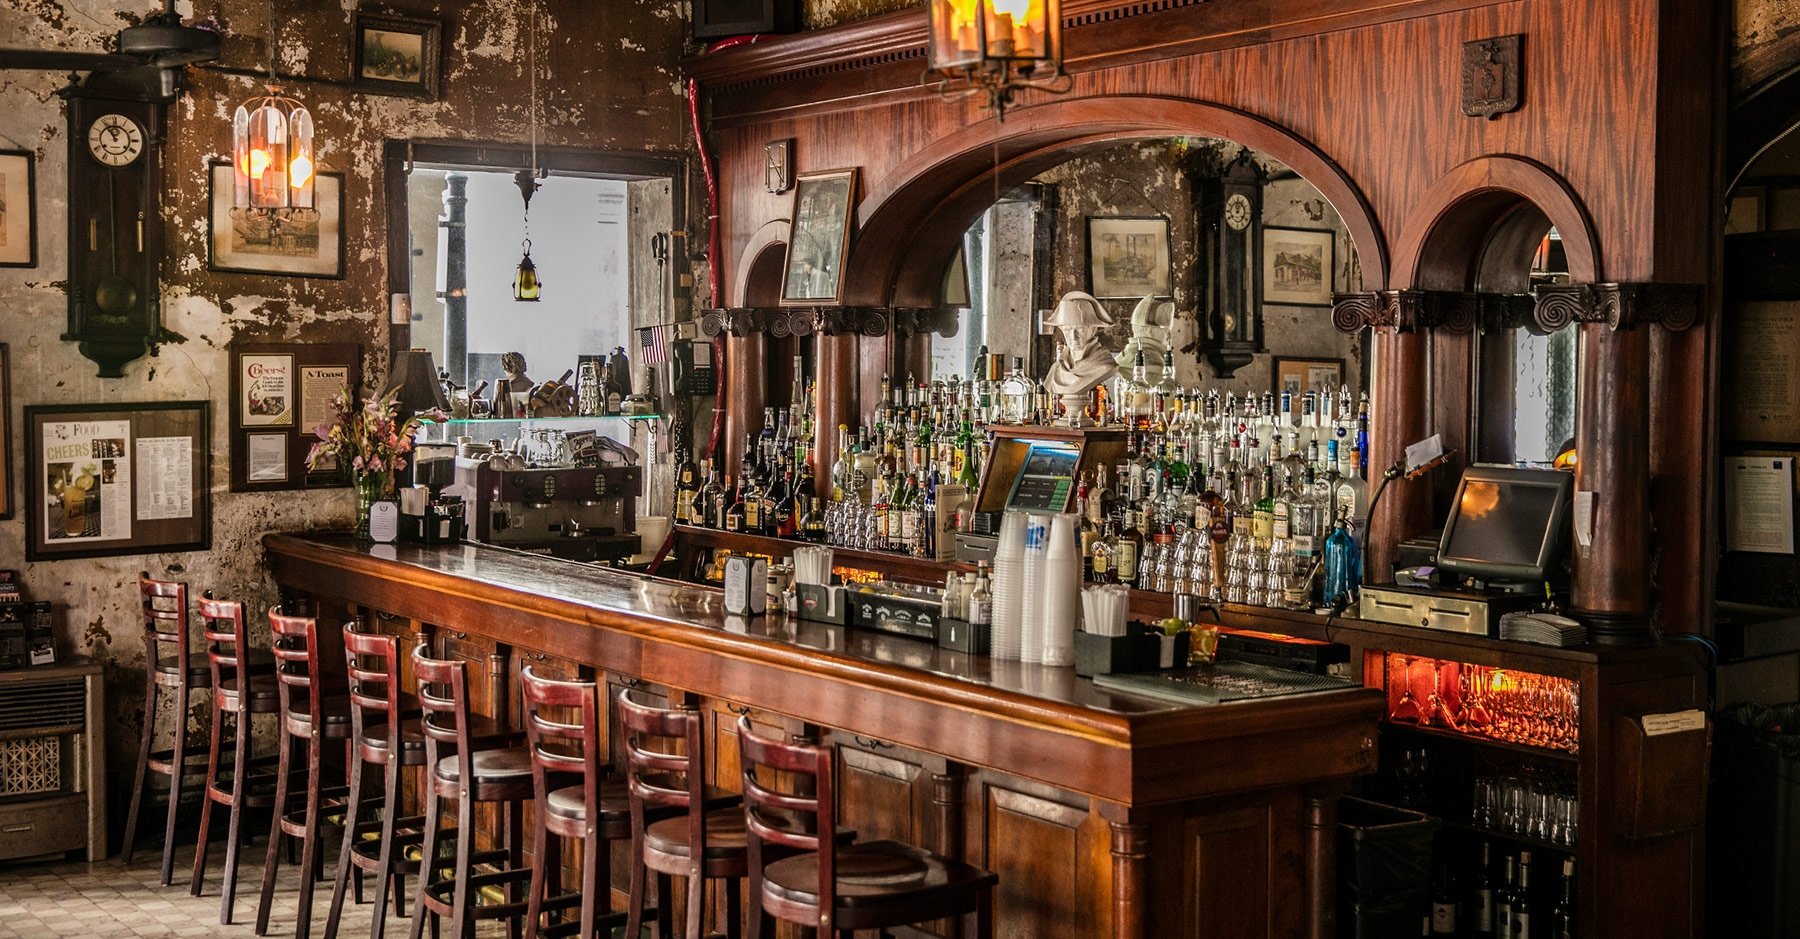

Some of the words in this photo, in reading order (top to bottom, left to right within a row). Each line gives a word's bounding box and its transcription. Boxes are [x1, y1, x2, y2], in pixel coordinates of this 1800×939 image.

[248, 363, 286, 378] Cheers!
[314, 370, 344, 378] Toast
[47, 443, 89, 461] CHEERS
